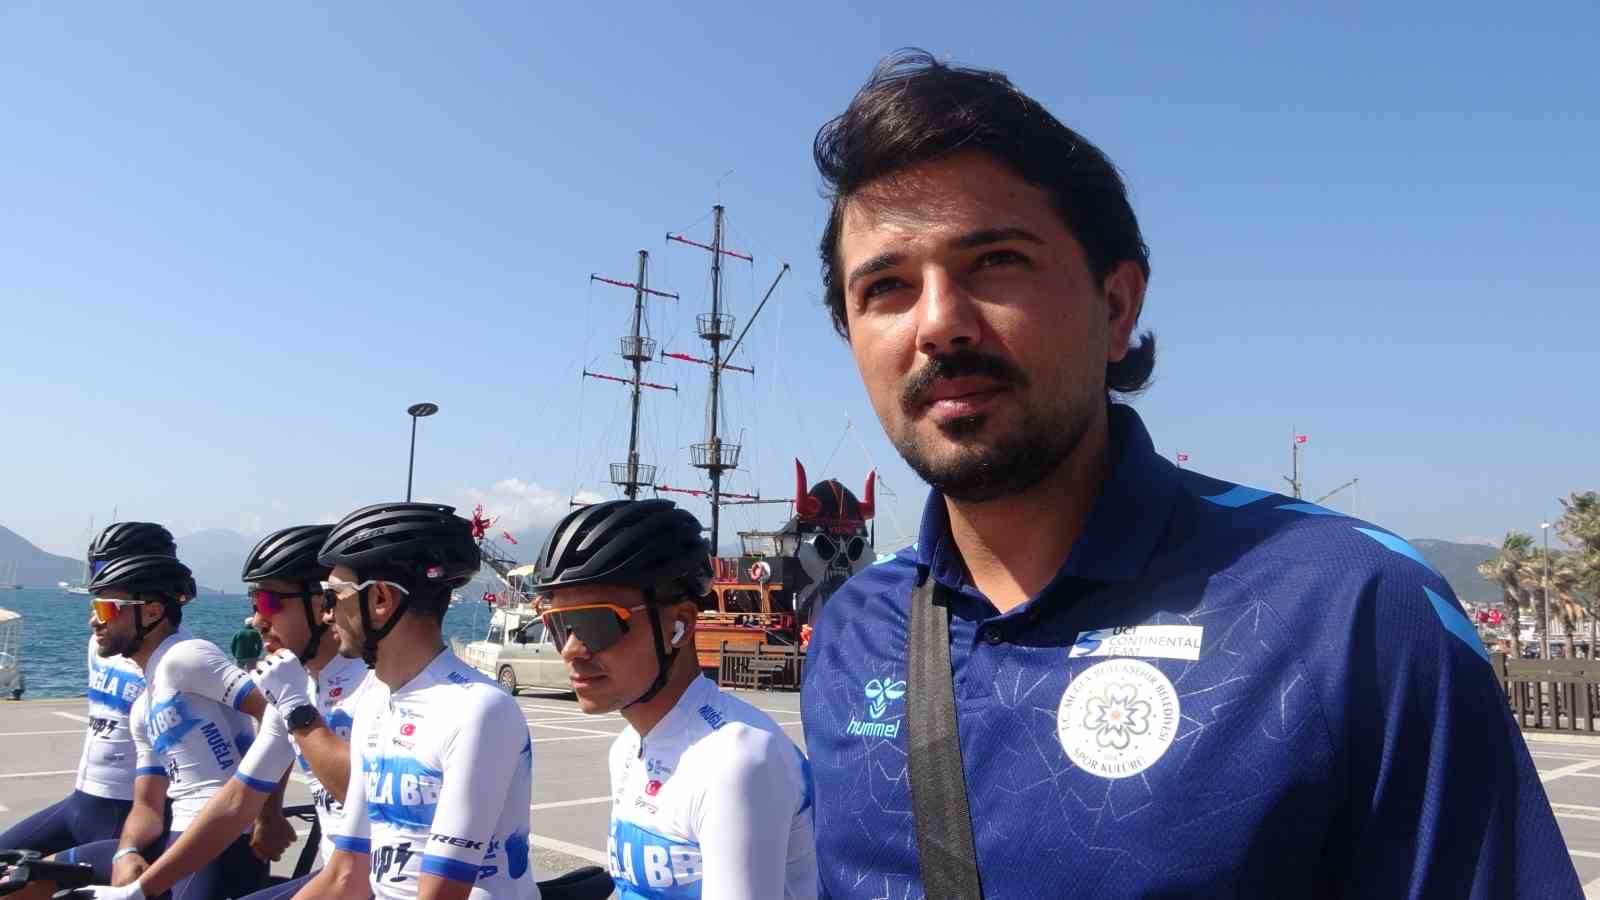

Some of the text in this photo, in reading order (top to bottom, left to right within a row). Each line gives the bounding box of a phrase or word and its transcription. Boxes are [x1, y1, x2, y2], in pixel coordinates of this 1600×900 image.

[1109, 636, 1201, 649] CONTINENTAL
[846, 716, 900, 739] hummel
[429, 832, 485, 851] REK
